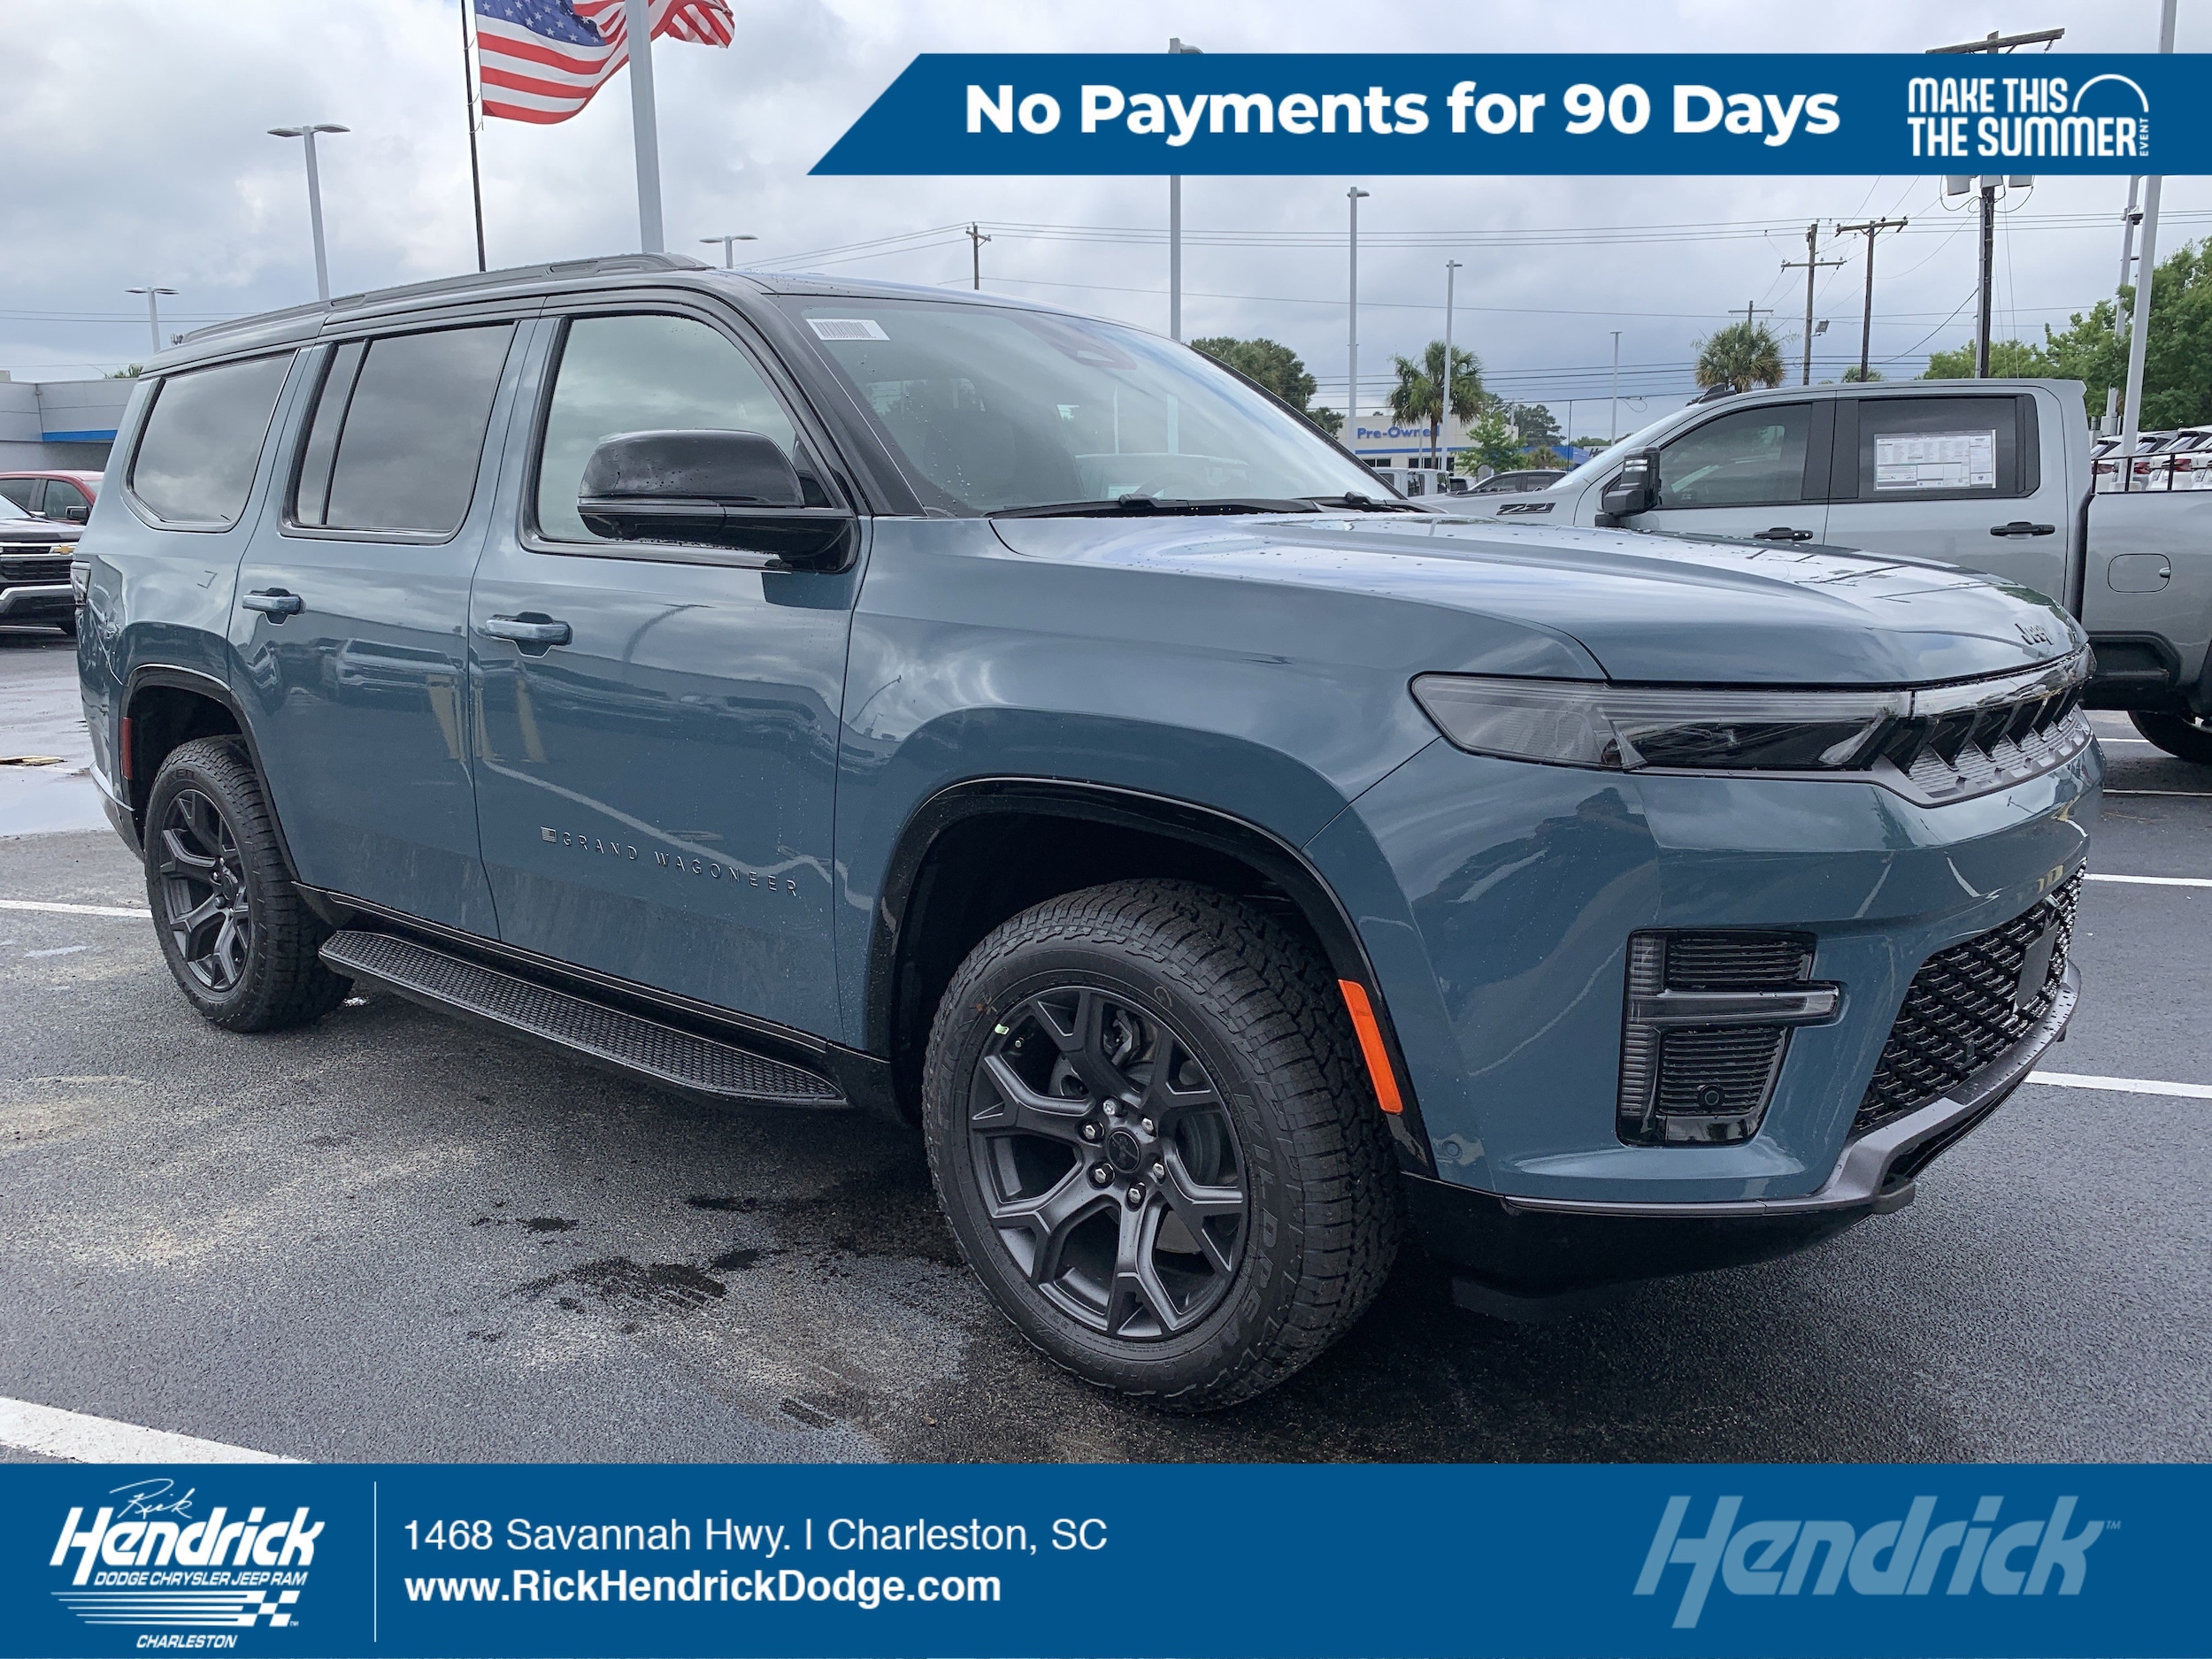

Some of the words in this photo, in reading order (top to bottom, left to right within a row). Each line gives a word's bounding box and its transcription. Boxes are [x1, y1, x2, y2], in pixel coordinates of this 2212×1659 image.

[2014, 622, 2055, 646] Jeep
[562, 832, 639, 862] GRAND
[654, 850, 798, 897] WAGONEER
